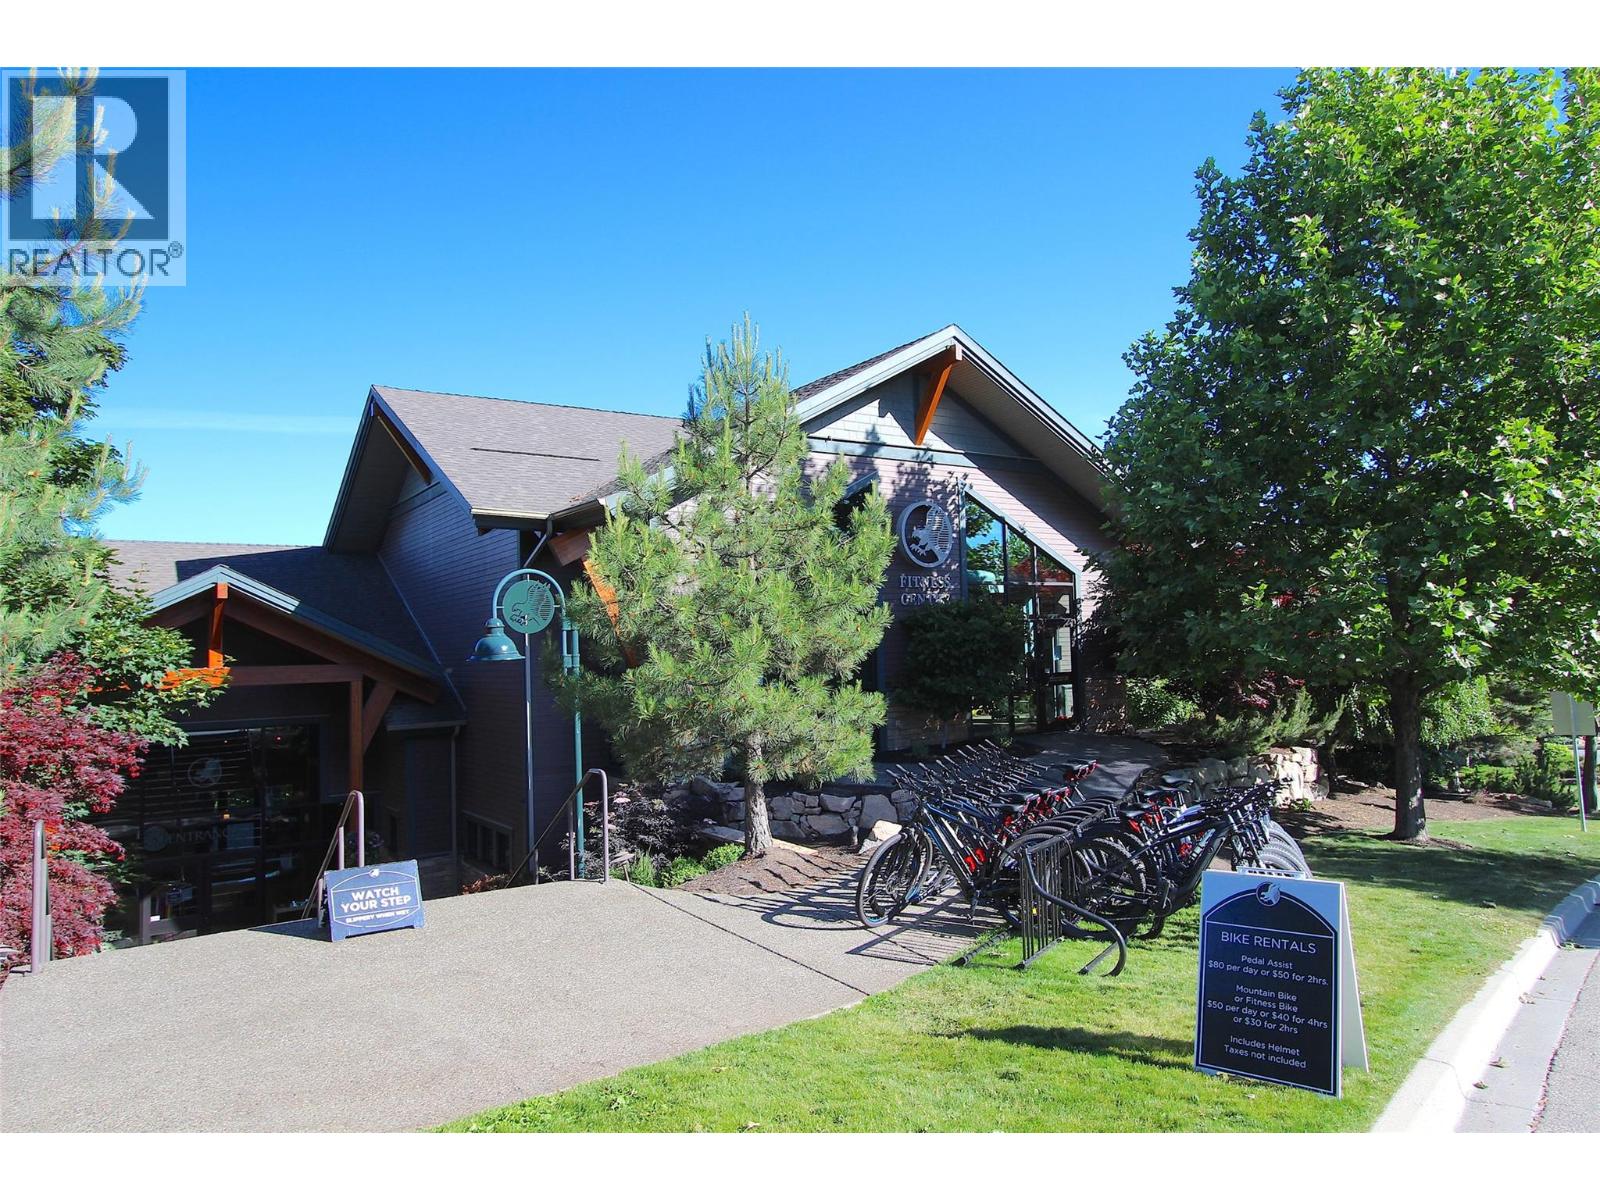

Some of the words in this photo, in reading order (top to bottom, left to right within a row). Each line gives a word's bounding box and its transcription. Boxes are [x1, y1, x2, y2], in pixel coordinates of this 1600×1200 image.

[900, 575, 952, 588] FITNESS
[901, 593, 951, 606] CENT
[352, 886, 399, 901] WATCH
[341, 900, 378, 913] YOUR
[381, 895, 411, 908] STEP
[1221, 931, 1250, 945] BIKE
[1254, 936, 1316, 954] RENTALS
[1241, 955, 1265, 965] Pedal
[1267, 959, 1293, 970] Assist
[1208, 960, 1224, 970] $80
[1226, 964, 1241, 972] per
[1243, 965, 1258, 976] day
[1272, 971, 1290, 980] $50
[1292, 972, 1305, 982] for
[1307, 975, 1329, 986] 2hrs.
[1236, 984, 1276, 998] Mountain
[1277, 991, 1297, 1002] Bike
[1234, 995, 1244, 1003] or
[1246, 996, 1276, 1009] Fitness
[1278, 1002, 1298, 1013] Bike
[1207, 1000, 1224, 1009] $50
[1225, 1004, 1240, 1013] per
[1242, 1006, 1258, 1017] day
[1272, 1011, 1290, 1021] $40
[1292, 1015, 1305, 1024] for
[1307, 1018, 1328, 1029] 4hrs
[1245, 1016, 1261, 1027] $30
[1263, 1020, 1277, 1029] for
[1279, 1023, 1298, 1034] 2hrs
[1230, 1035, 1266, 1049] Includes
[1268, 1043, 1300, 1056] Helmet
[1224, 1044, 1249, 1057] Taxes
[1251, 1050, 1266, 1060] not
[1268, 1053, 1307, 1068] included
